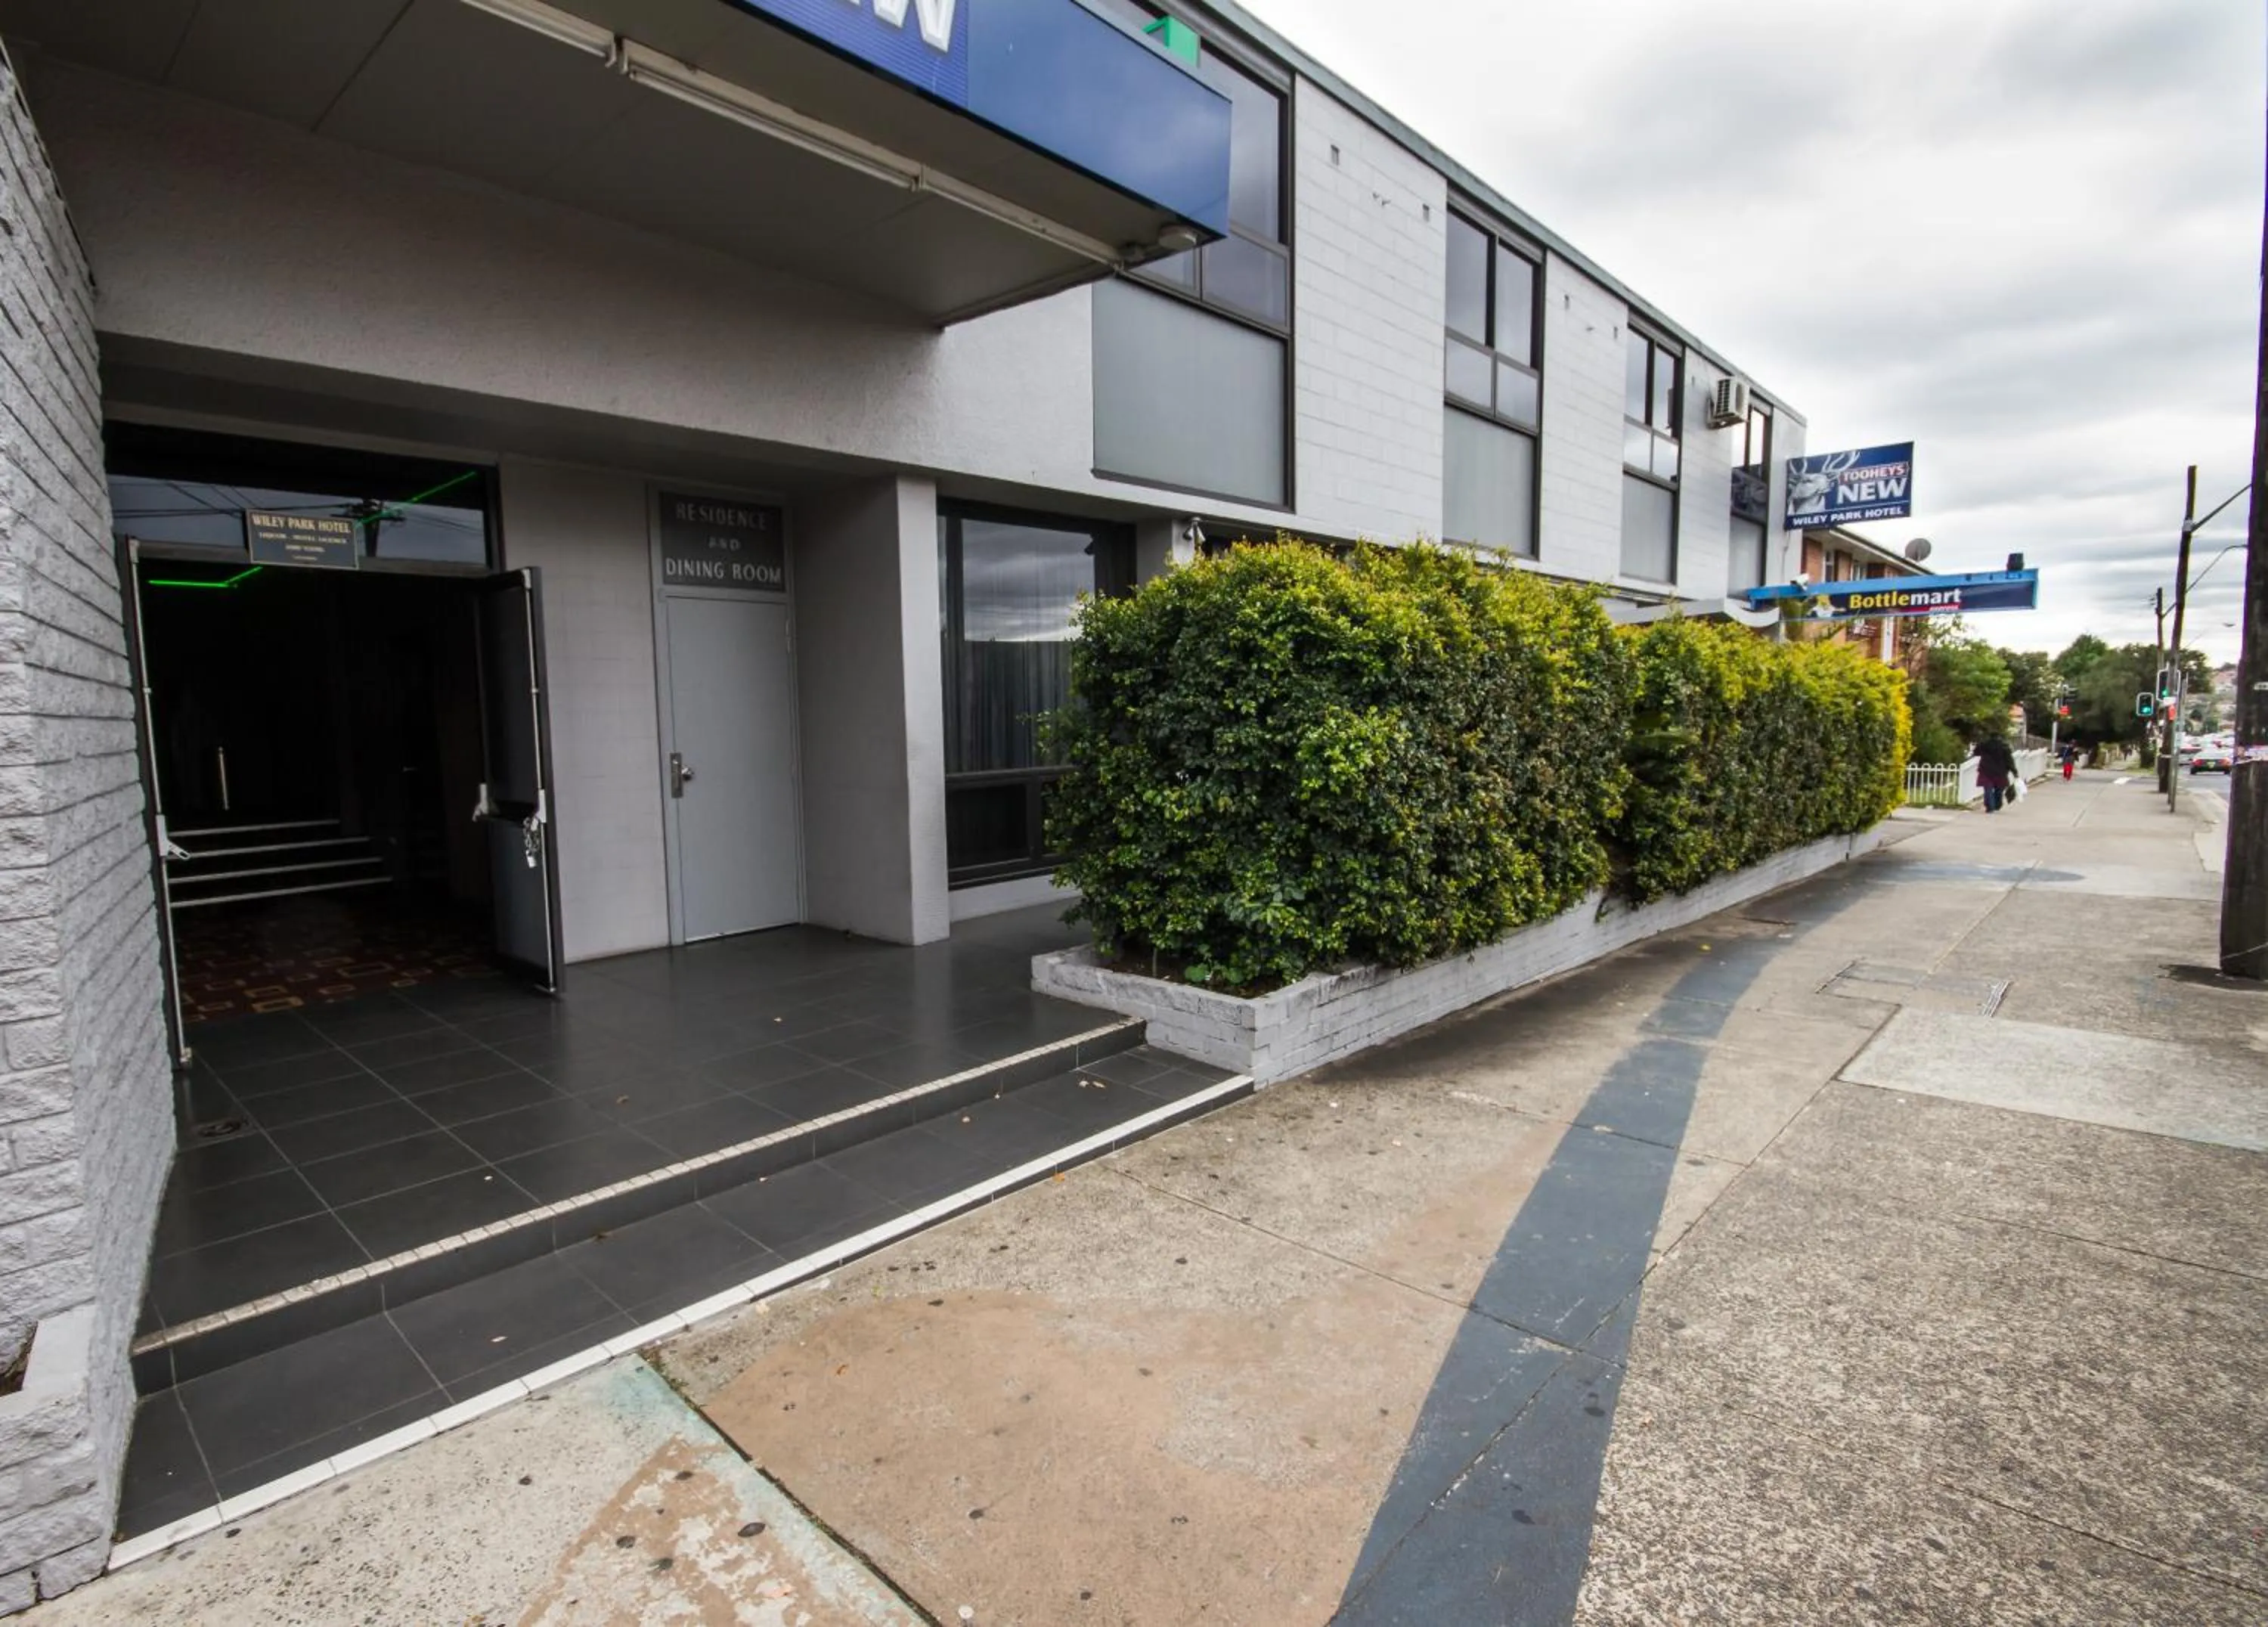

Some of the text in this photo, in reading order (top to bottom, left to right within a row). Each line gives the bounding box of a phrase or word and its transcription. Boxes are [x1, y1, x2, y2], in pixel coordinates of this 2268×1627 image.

[1843, 465, 1904, 482] TOOHEYS
[1836, 478, 1907, 504] NEW
[251, 513, 352, 533] WILEY PARK HOTEL
[676, 502, 766, 530] RESIDENCE
[1792, 507, 1904, 525] WILEY PARK HOTEL
[665, 557, 782, 584] DINING ROOM
[1849, 588, 1962, 609] Bottlemart
